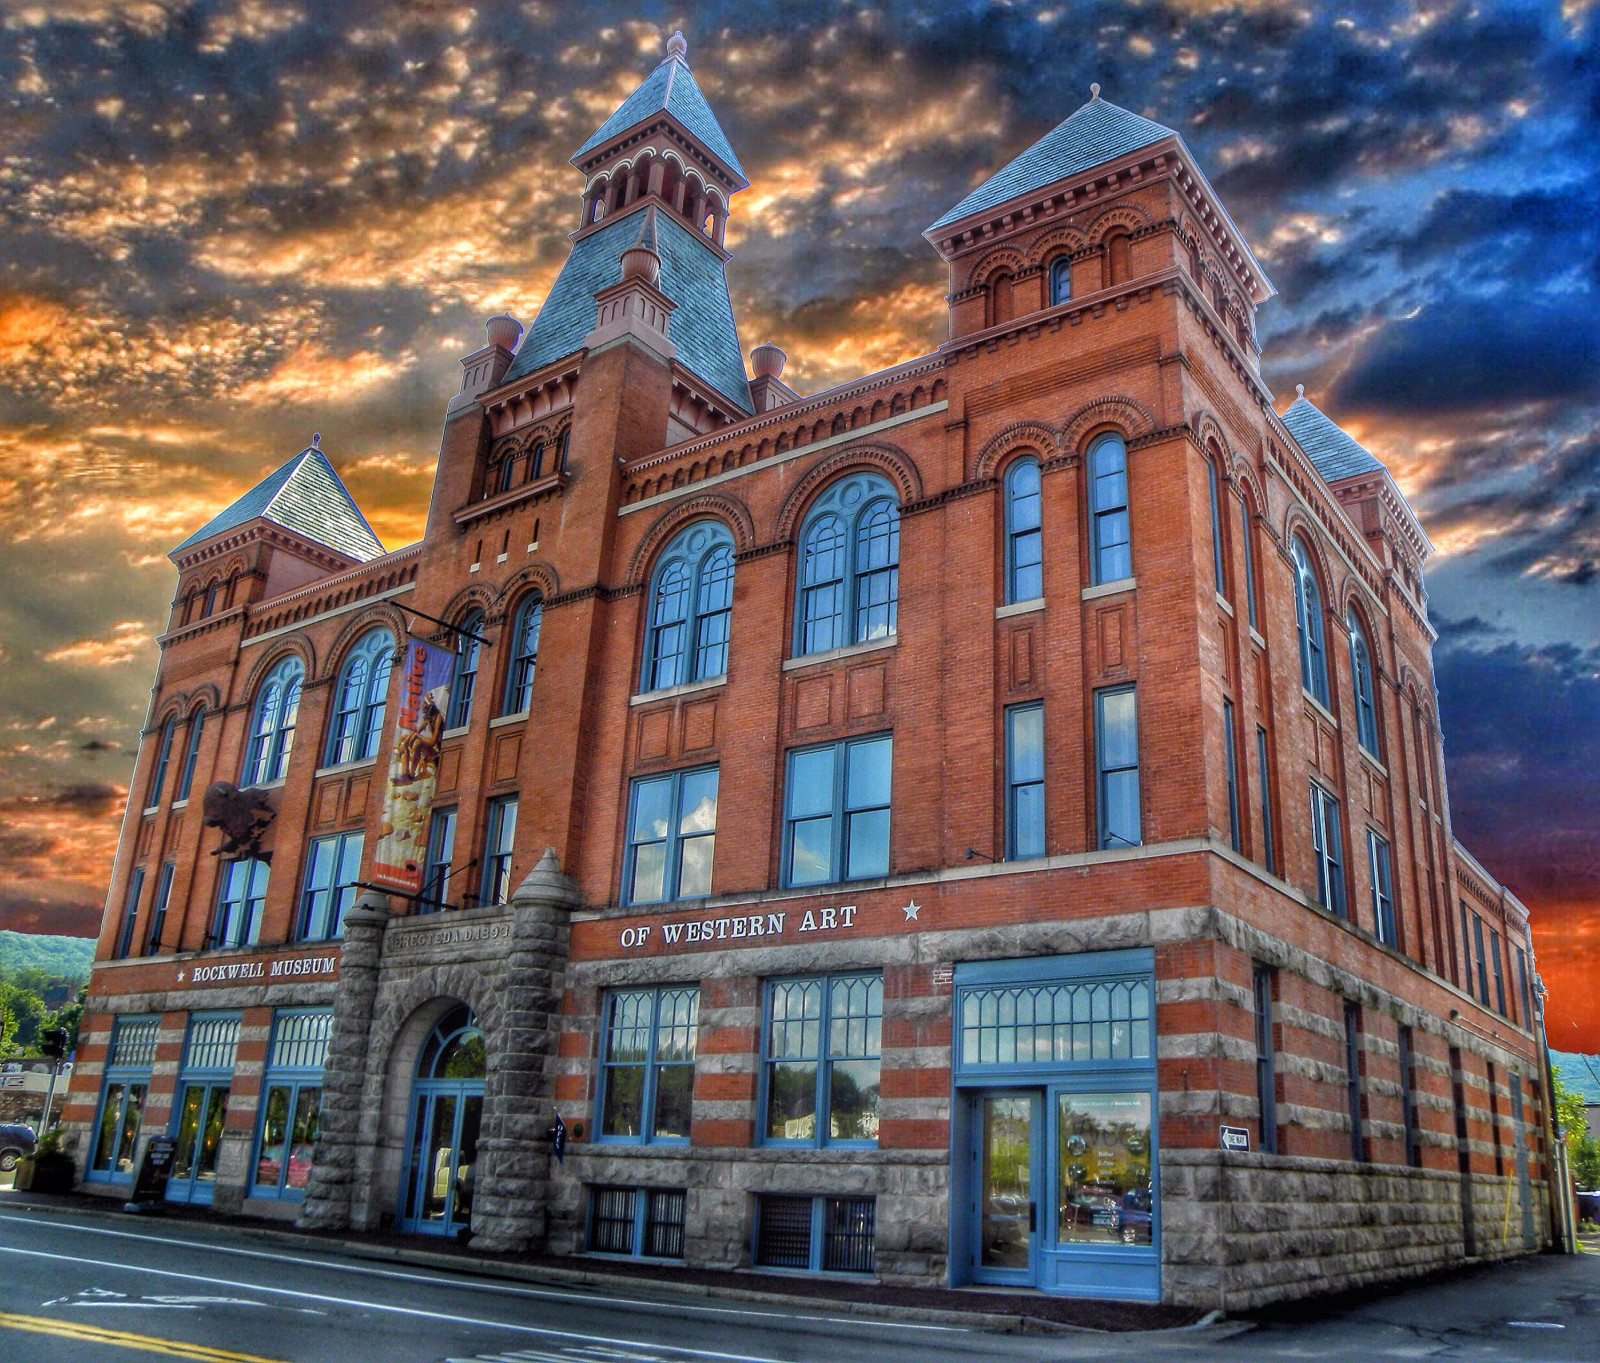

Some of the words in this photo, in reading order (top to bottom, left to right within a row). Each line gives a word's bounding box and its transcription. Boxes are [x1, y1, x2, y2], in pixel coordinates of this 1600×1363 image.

[399, 646, 427, 729] Native
[393, 931, 452, 949] ERECTED
[475, 925, 511, 941] 1893
[620, 926, 651, 948] OF
[662, 912, 786, 944] WESTERN
[799, 905, 857, 932] ART
[192, 962, 265, 983] ROCKWELL
[270, 957, 336, 977] MUSEUM
[1228, 1134, 1236, 1144] ONE
[1236, 1136, 1245, 1145] WAY
